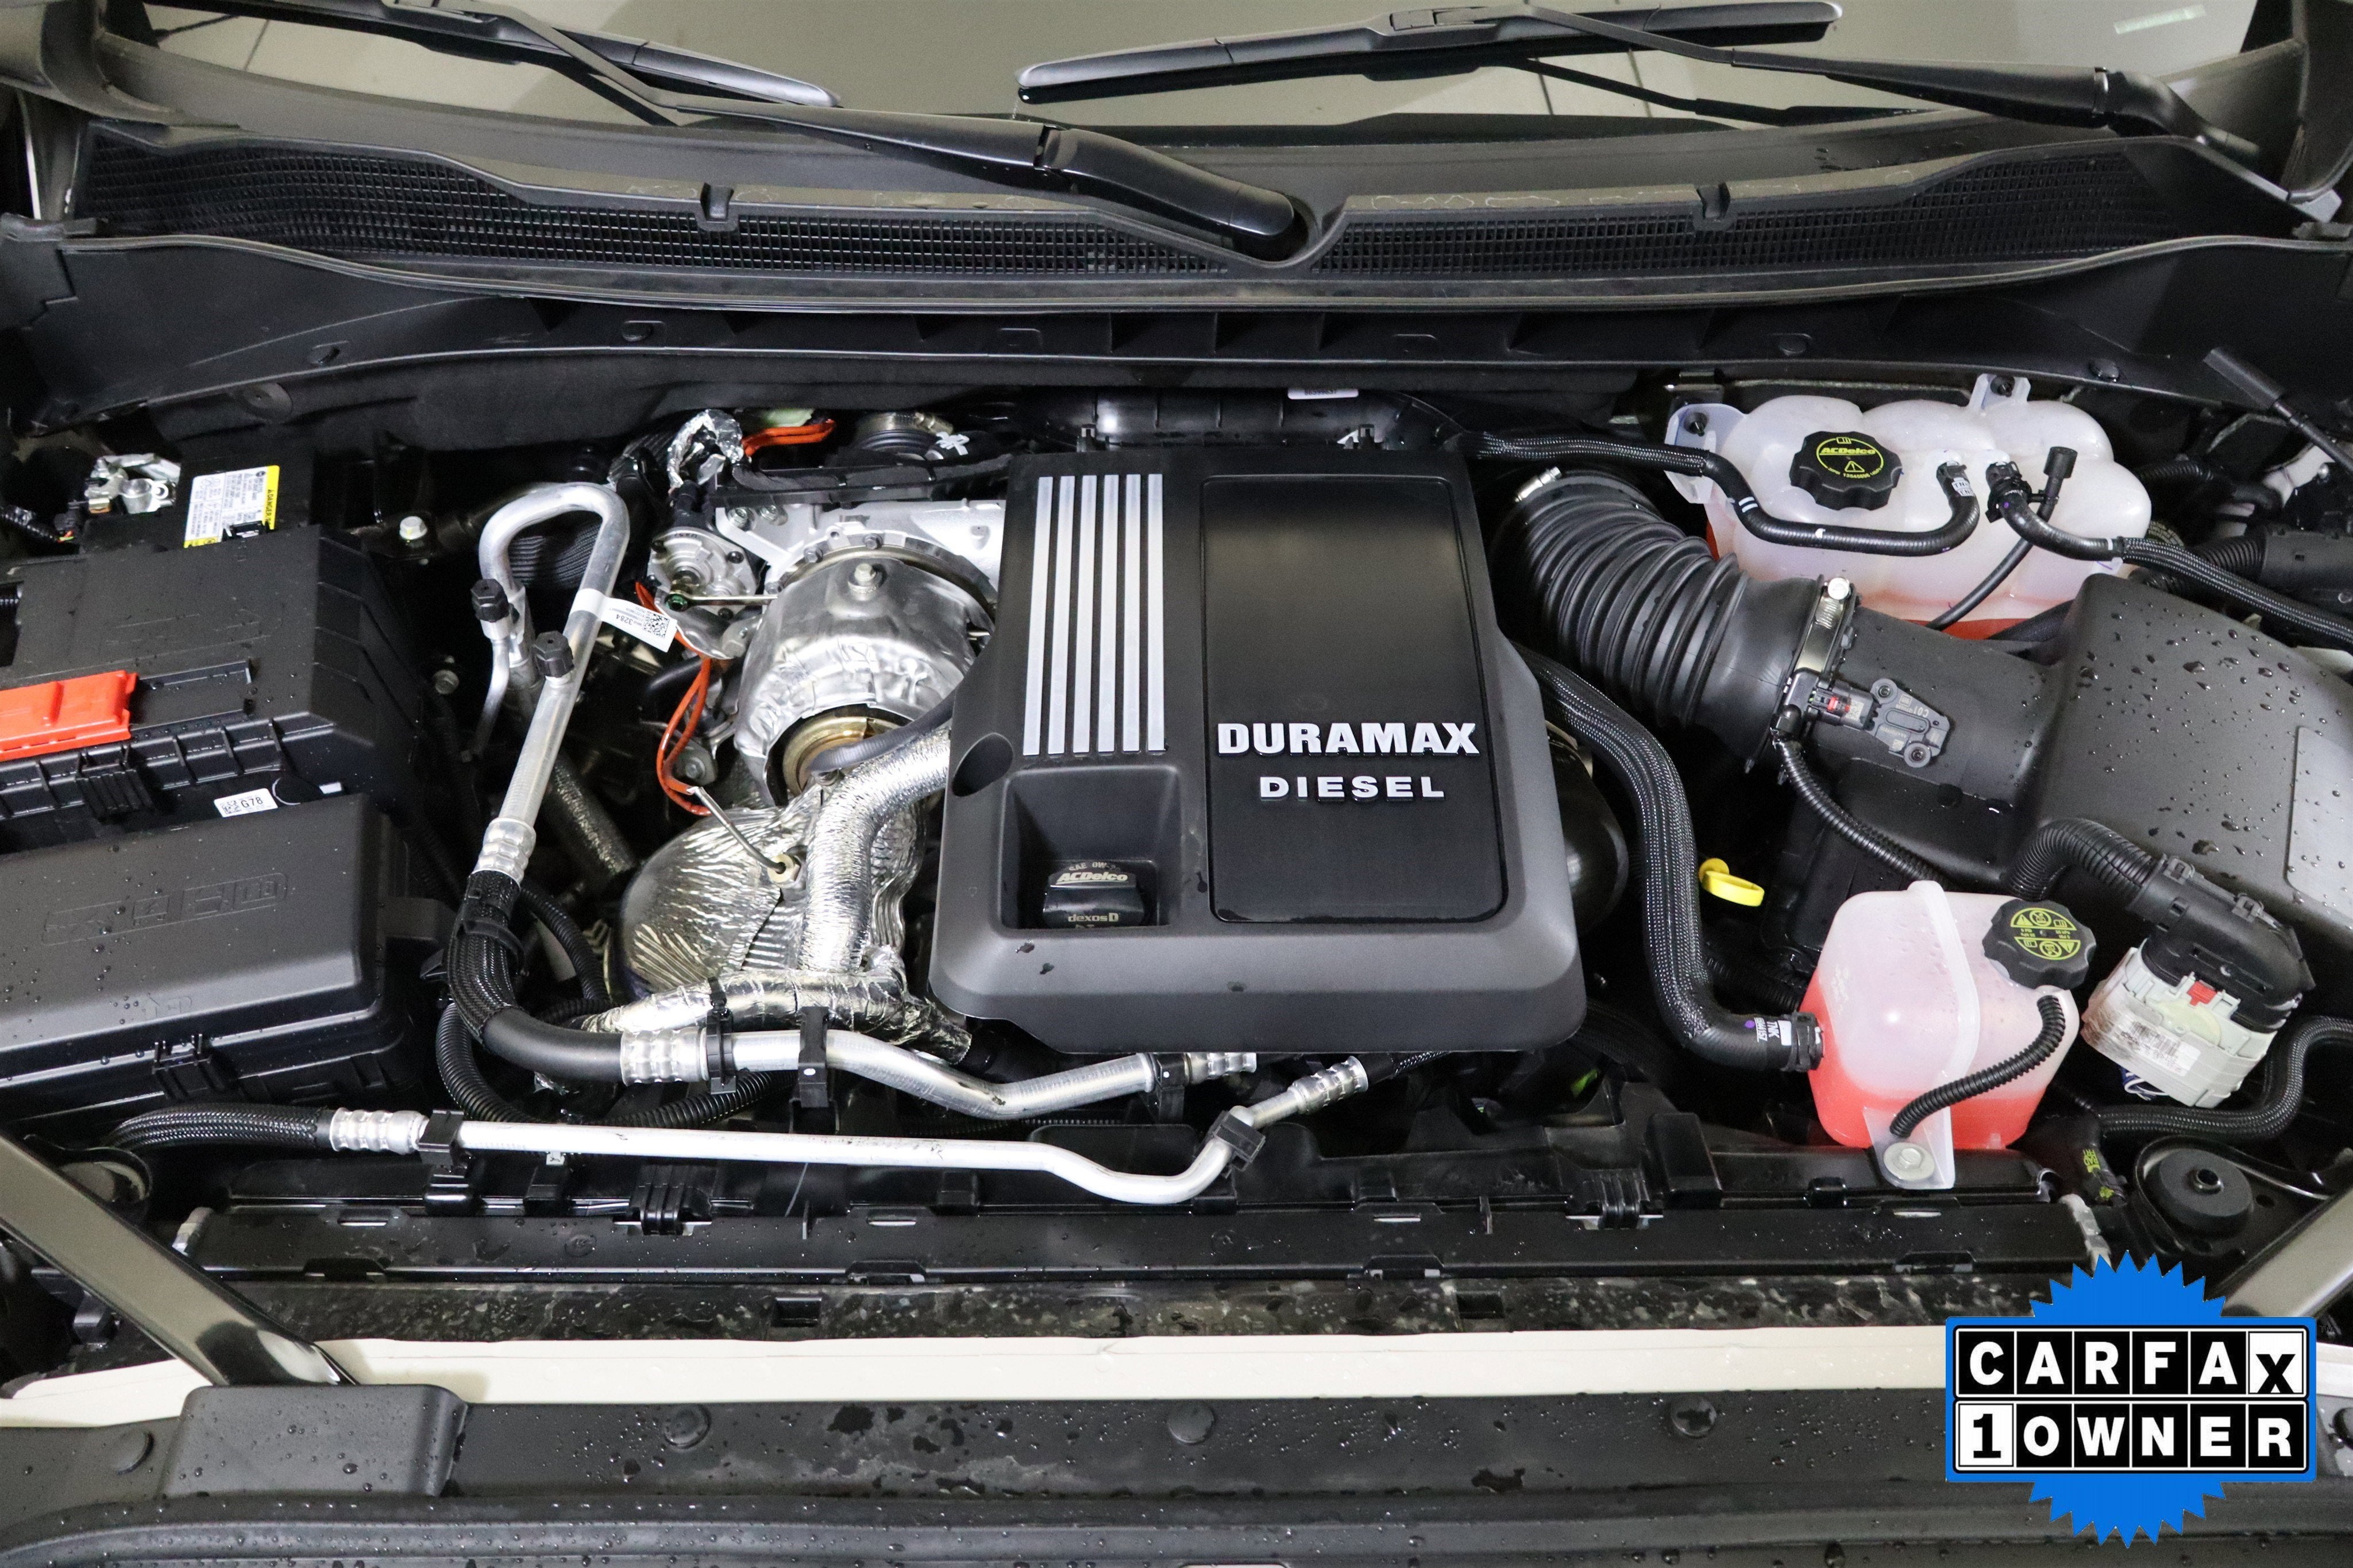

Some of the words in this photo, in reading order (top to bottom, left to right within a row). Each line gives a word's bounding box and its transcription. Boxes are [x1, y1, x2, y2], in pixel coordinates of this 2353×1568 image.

[1820, 447, 1876, 455] ACDelco
[616, 613, 634, 625] 3284
[1217, 722, 1480, 755] DURAMAX
[1260, 775, 1445, 799] DIESEL
[241, 797, 264, 808] G78
[1069, 862, 1087, 871] SAE
[1056, 871, 1128, 883] ACDelco
[1766, 1021, 1780, 1038] TNK
